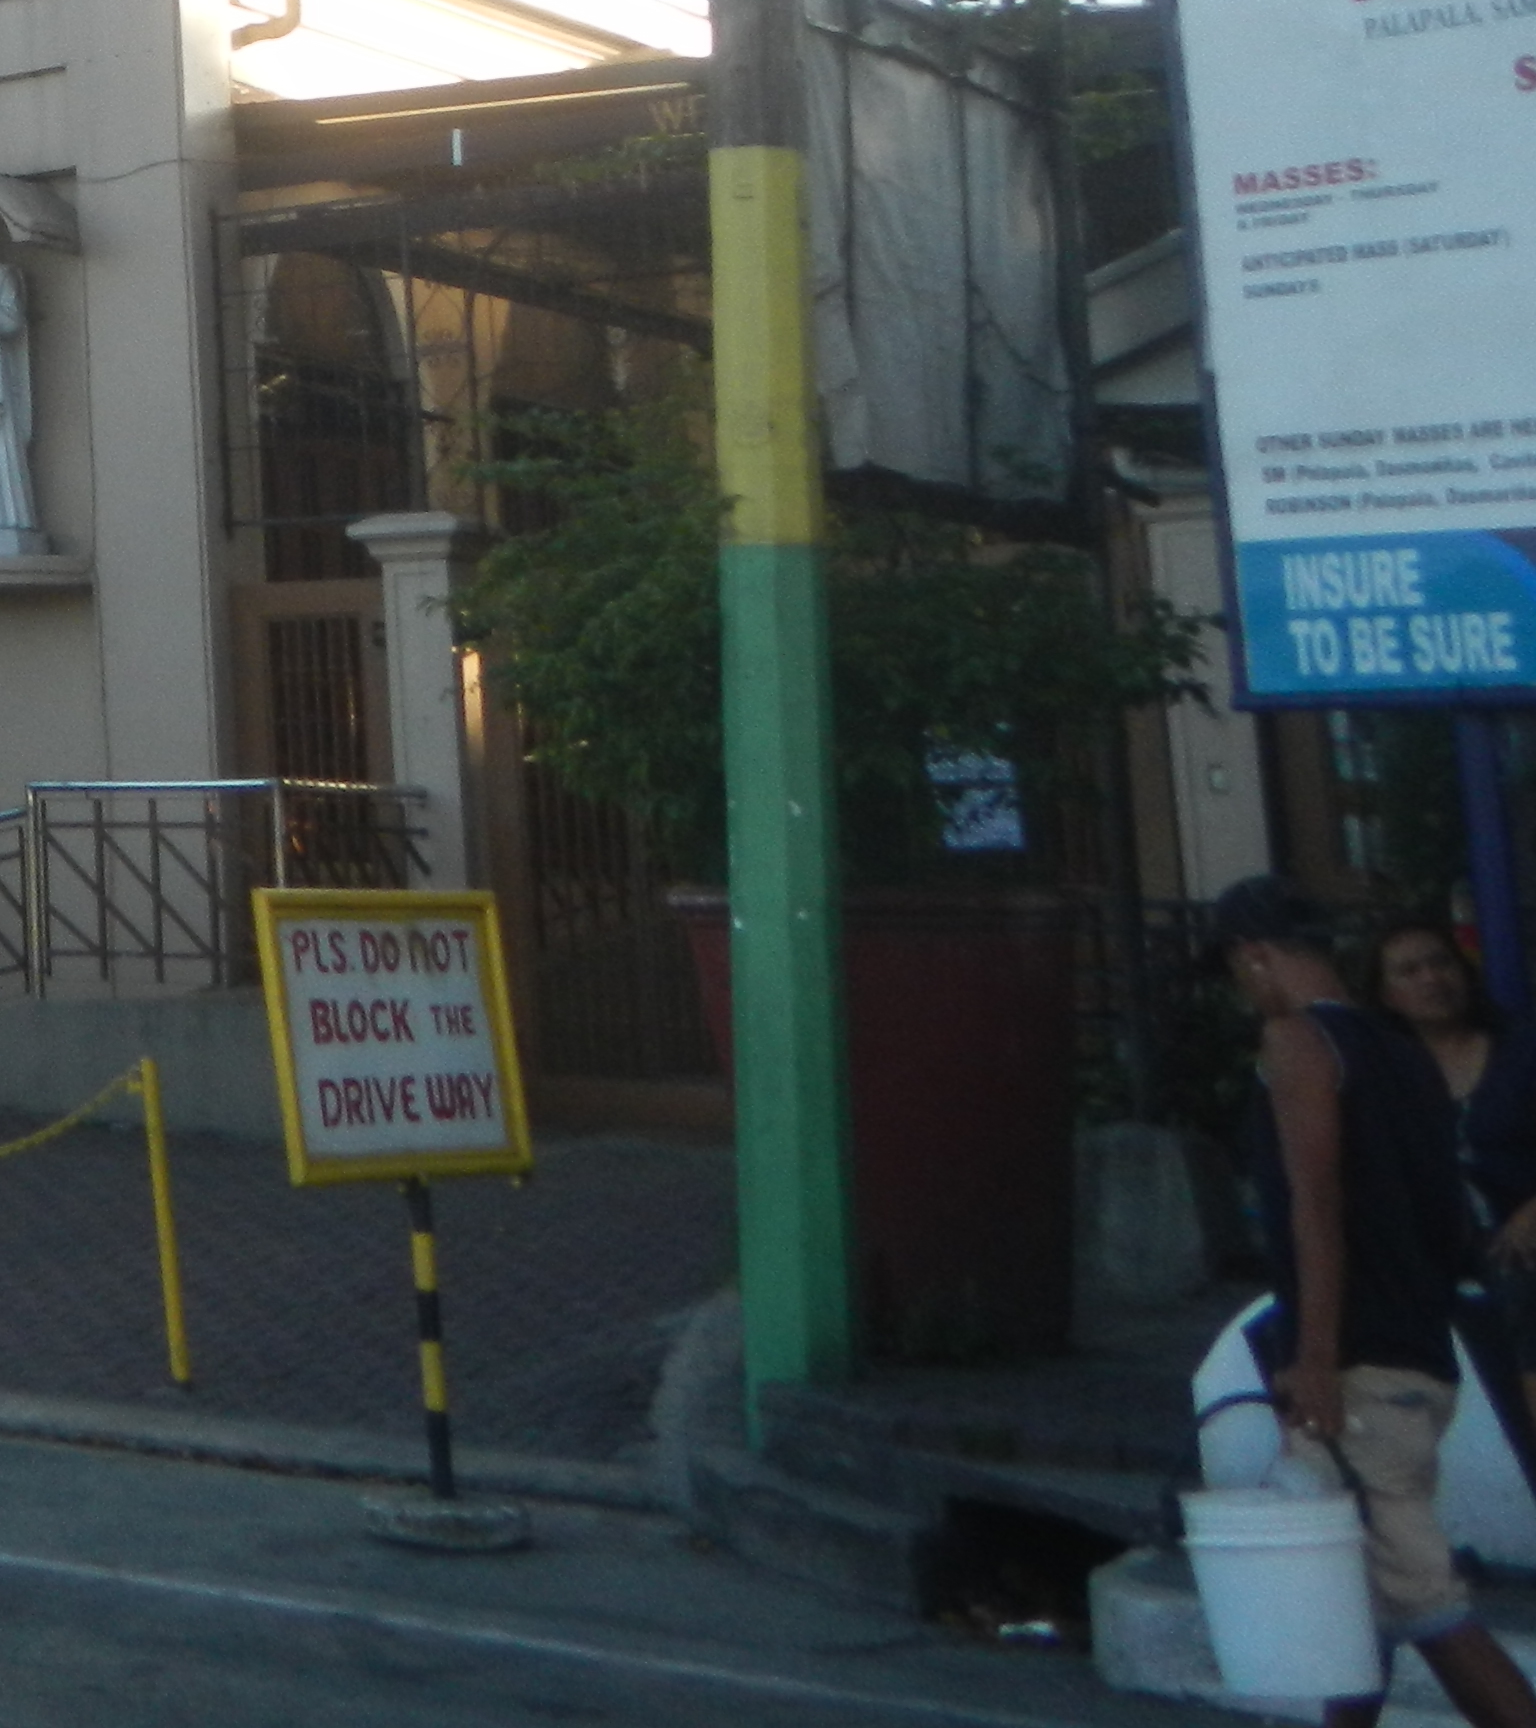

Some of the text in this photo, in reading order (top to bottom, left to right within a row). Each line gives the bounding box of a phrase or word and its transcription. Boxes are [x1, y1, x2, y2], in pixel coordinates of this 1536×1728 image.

[1233, 157, 1380, 195] MASSES:
[1282, 547, 1426, 611] INSURE
[1288, 611, 1519, 676] TO BE SURE
[358, 928, 403, 974] DO
[408, 928, 471, 973] NOT
[309, 997, 477, 1046] BLOCK THE
